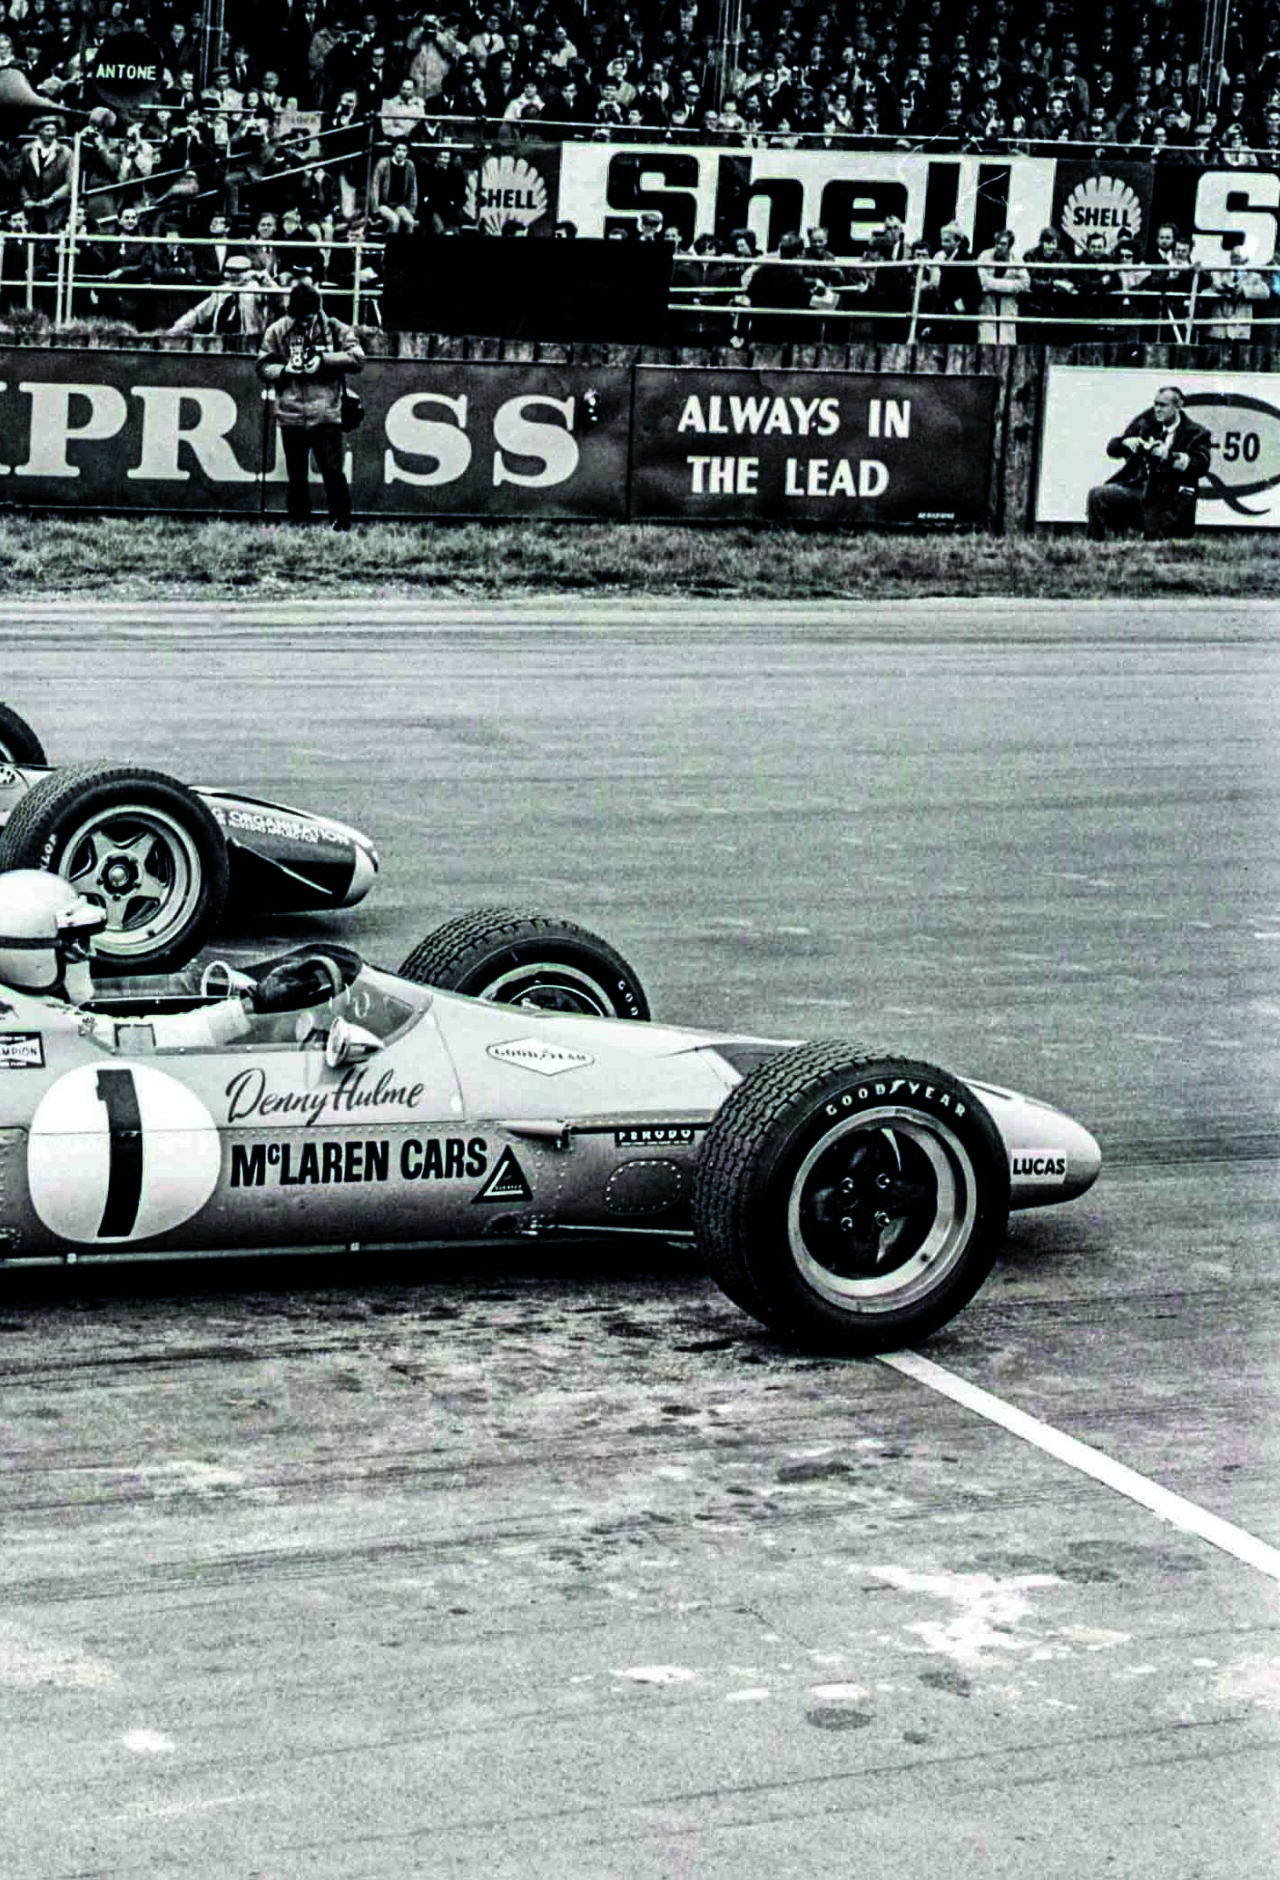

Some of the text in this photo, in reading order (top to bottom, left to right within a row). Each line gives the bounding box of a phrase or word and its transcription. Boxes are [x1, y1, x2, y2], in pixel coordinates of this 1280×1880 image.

[96, 64, 157, 81] ANTONE
[477, 188, 537, 209] SHELL
[605, 151, 1011, 259] Shell
[1073, 206, 1131, 227] SHELL
[677, 396, 910, 438] ALWAYS IN
[686, 456, 890, 498] THE LEAD
[225, 1068, 425, 1126] Denny Hulme
[826, 1079, 966, 1118] GOODYEAR
[96, 1069, 143, 1237] 1
[230, 1137, 488, 1187] McLAREN CARS
[1013, 1157, 1066, 1176] LUCAS
